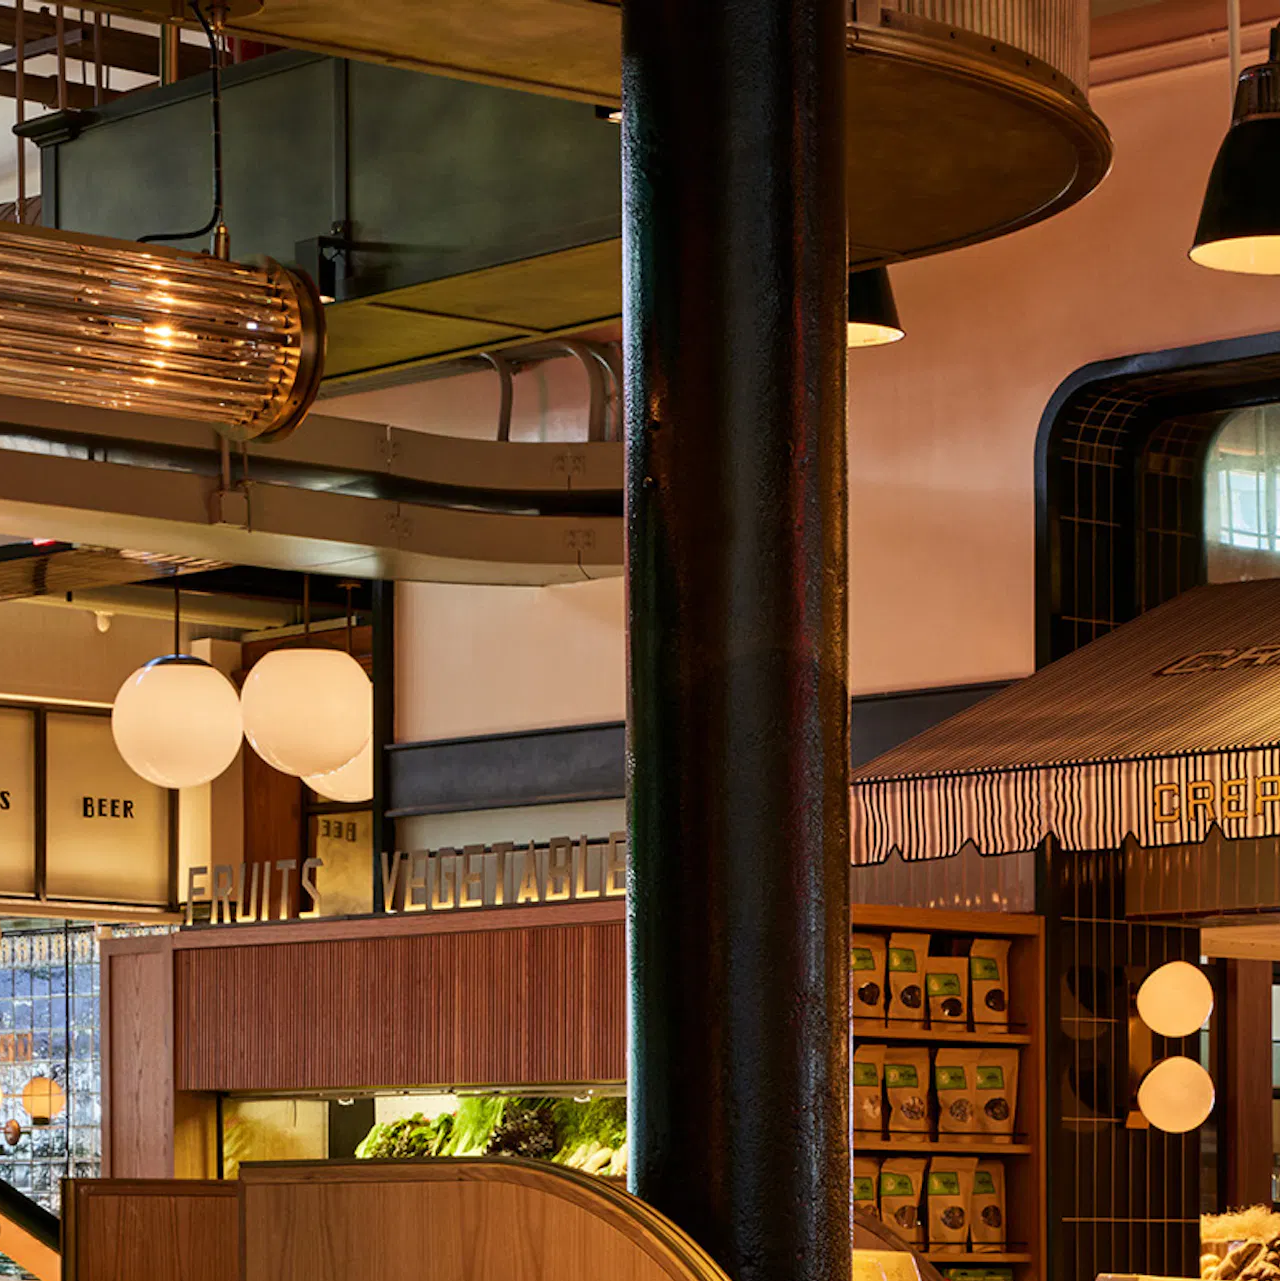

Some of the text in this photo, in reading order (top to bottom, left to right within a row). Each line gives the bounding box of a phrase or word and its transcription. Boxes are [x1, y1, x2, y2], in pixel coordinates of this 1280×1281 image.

[83, 797, 134, 818] BEER
[186, 831, 626, 926] FRUITS VEGETABLE
